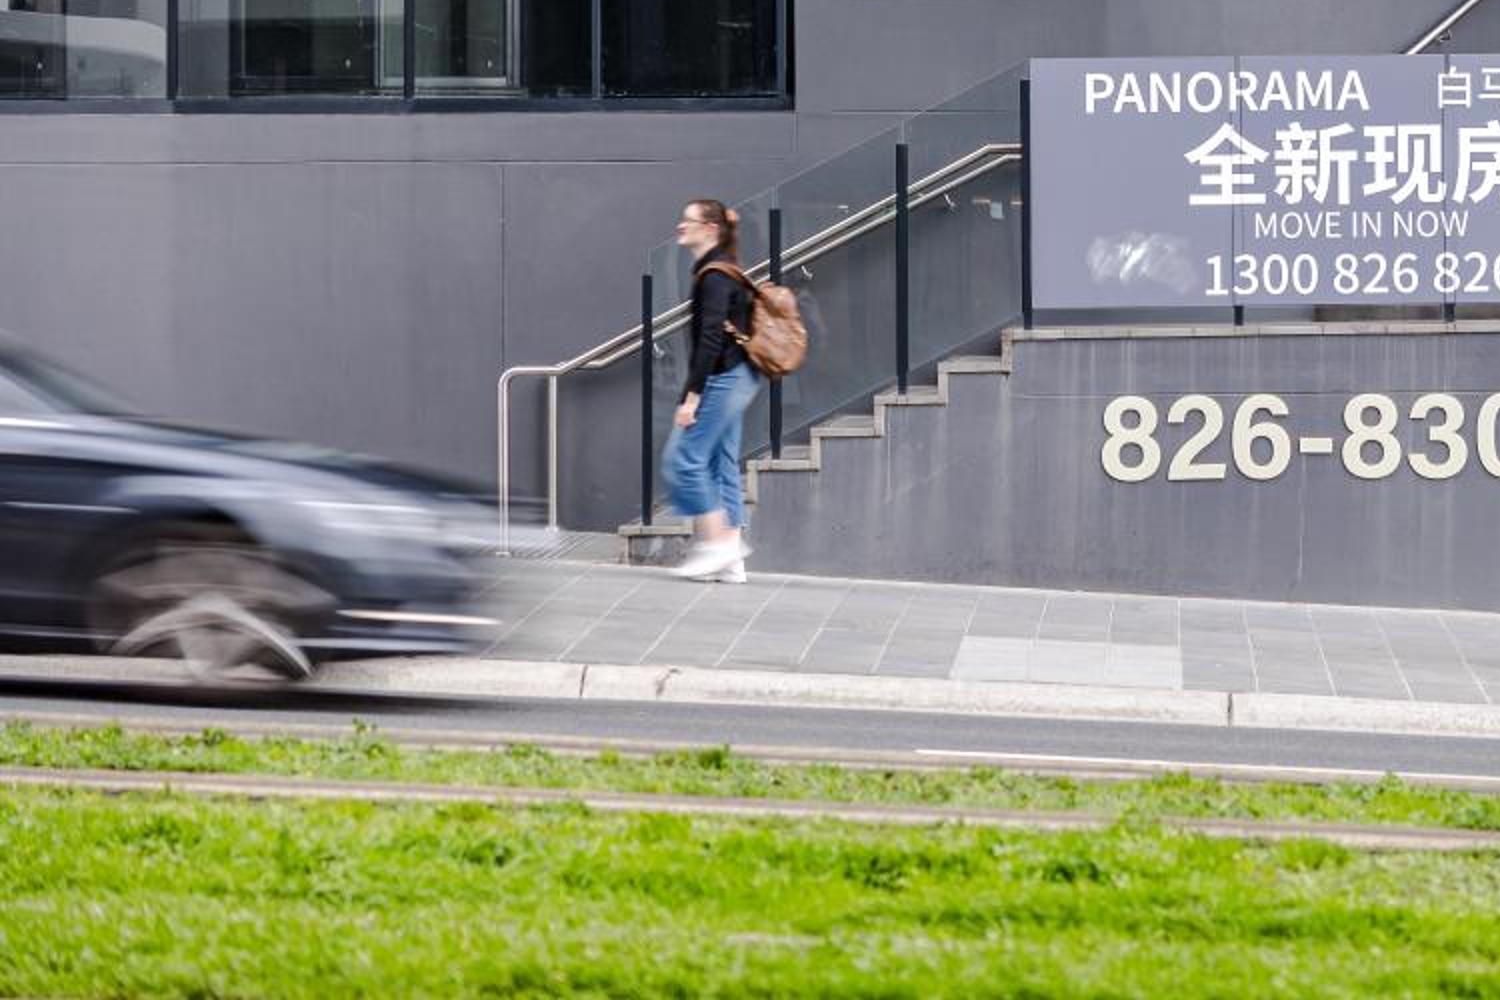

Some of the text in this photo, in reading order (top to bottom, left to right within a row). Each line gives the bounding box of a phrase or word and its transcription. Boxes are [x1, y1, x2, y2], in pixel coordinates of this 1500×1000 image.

[1085, 70, 1370, 113] PANORAMA
[1255, 209, 1469, 239] MOVE IN NOW
[1204, 253, 1319, 297] 1300
[1332, 252, 1418, 294] 826
